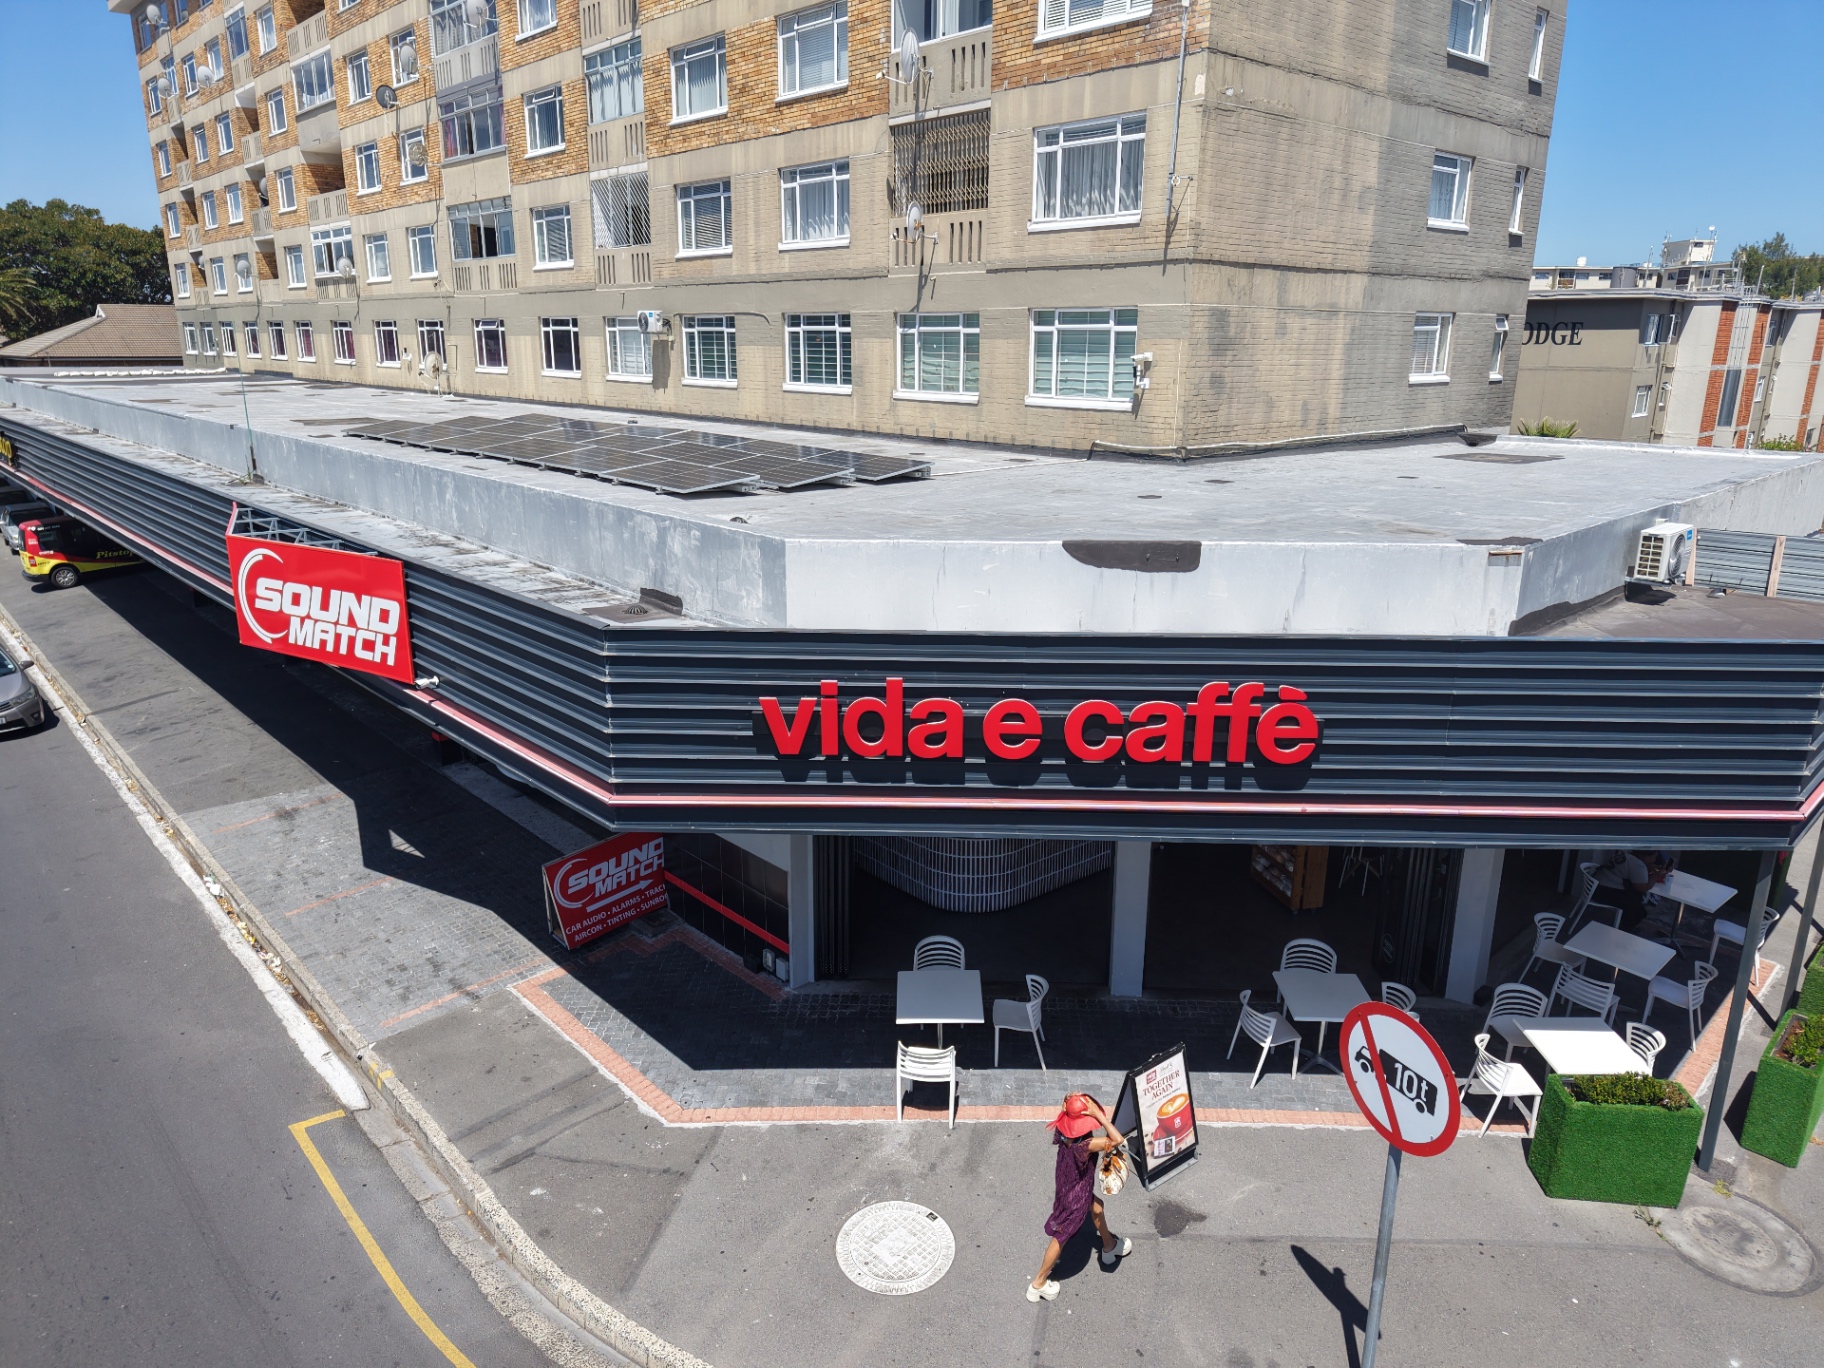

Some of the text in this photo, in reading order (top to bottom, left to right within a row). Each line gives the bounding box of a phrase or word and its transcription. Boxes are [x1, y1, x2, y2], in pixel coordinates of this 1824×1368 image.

[254, 576, 401, 636] SOUND
[288, 616, 398, 666] MATCH
[758, 676, 1320, 765] vida e caffè
[567, 836, 665, 895] SOUND
[594, 852, 665, 898] MATCH
[565, 924, 582, 935] CAR
[582, 911, 607, 928] AUDIO
[611, 896, 641, 915] ALARMS
[574, 924, 603, 942] AIRCON
[606, 908, 637, 926] TINTING
[1143, 1069, 1180, 1096] TOGETHER
[1152, 1082, 1173, 1100] AGAIN
